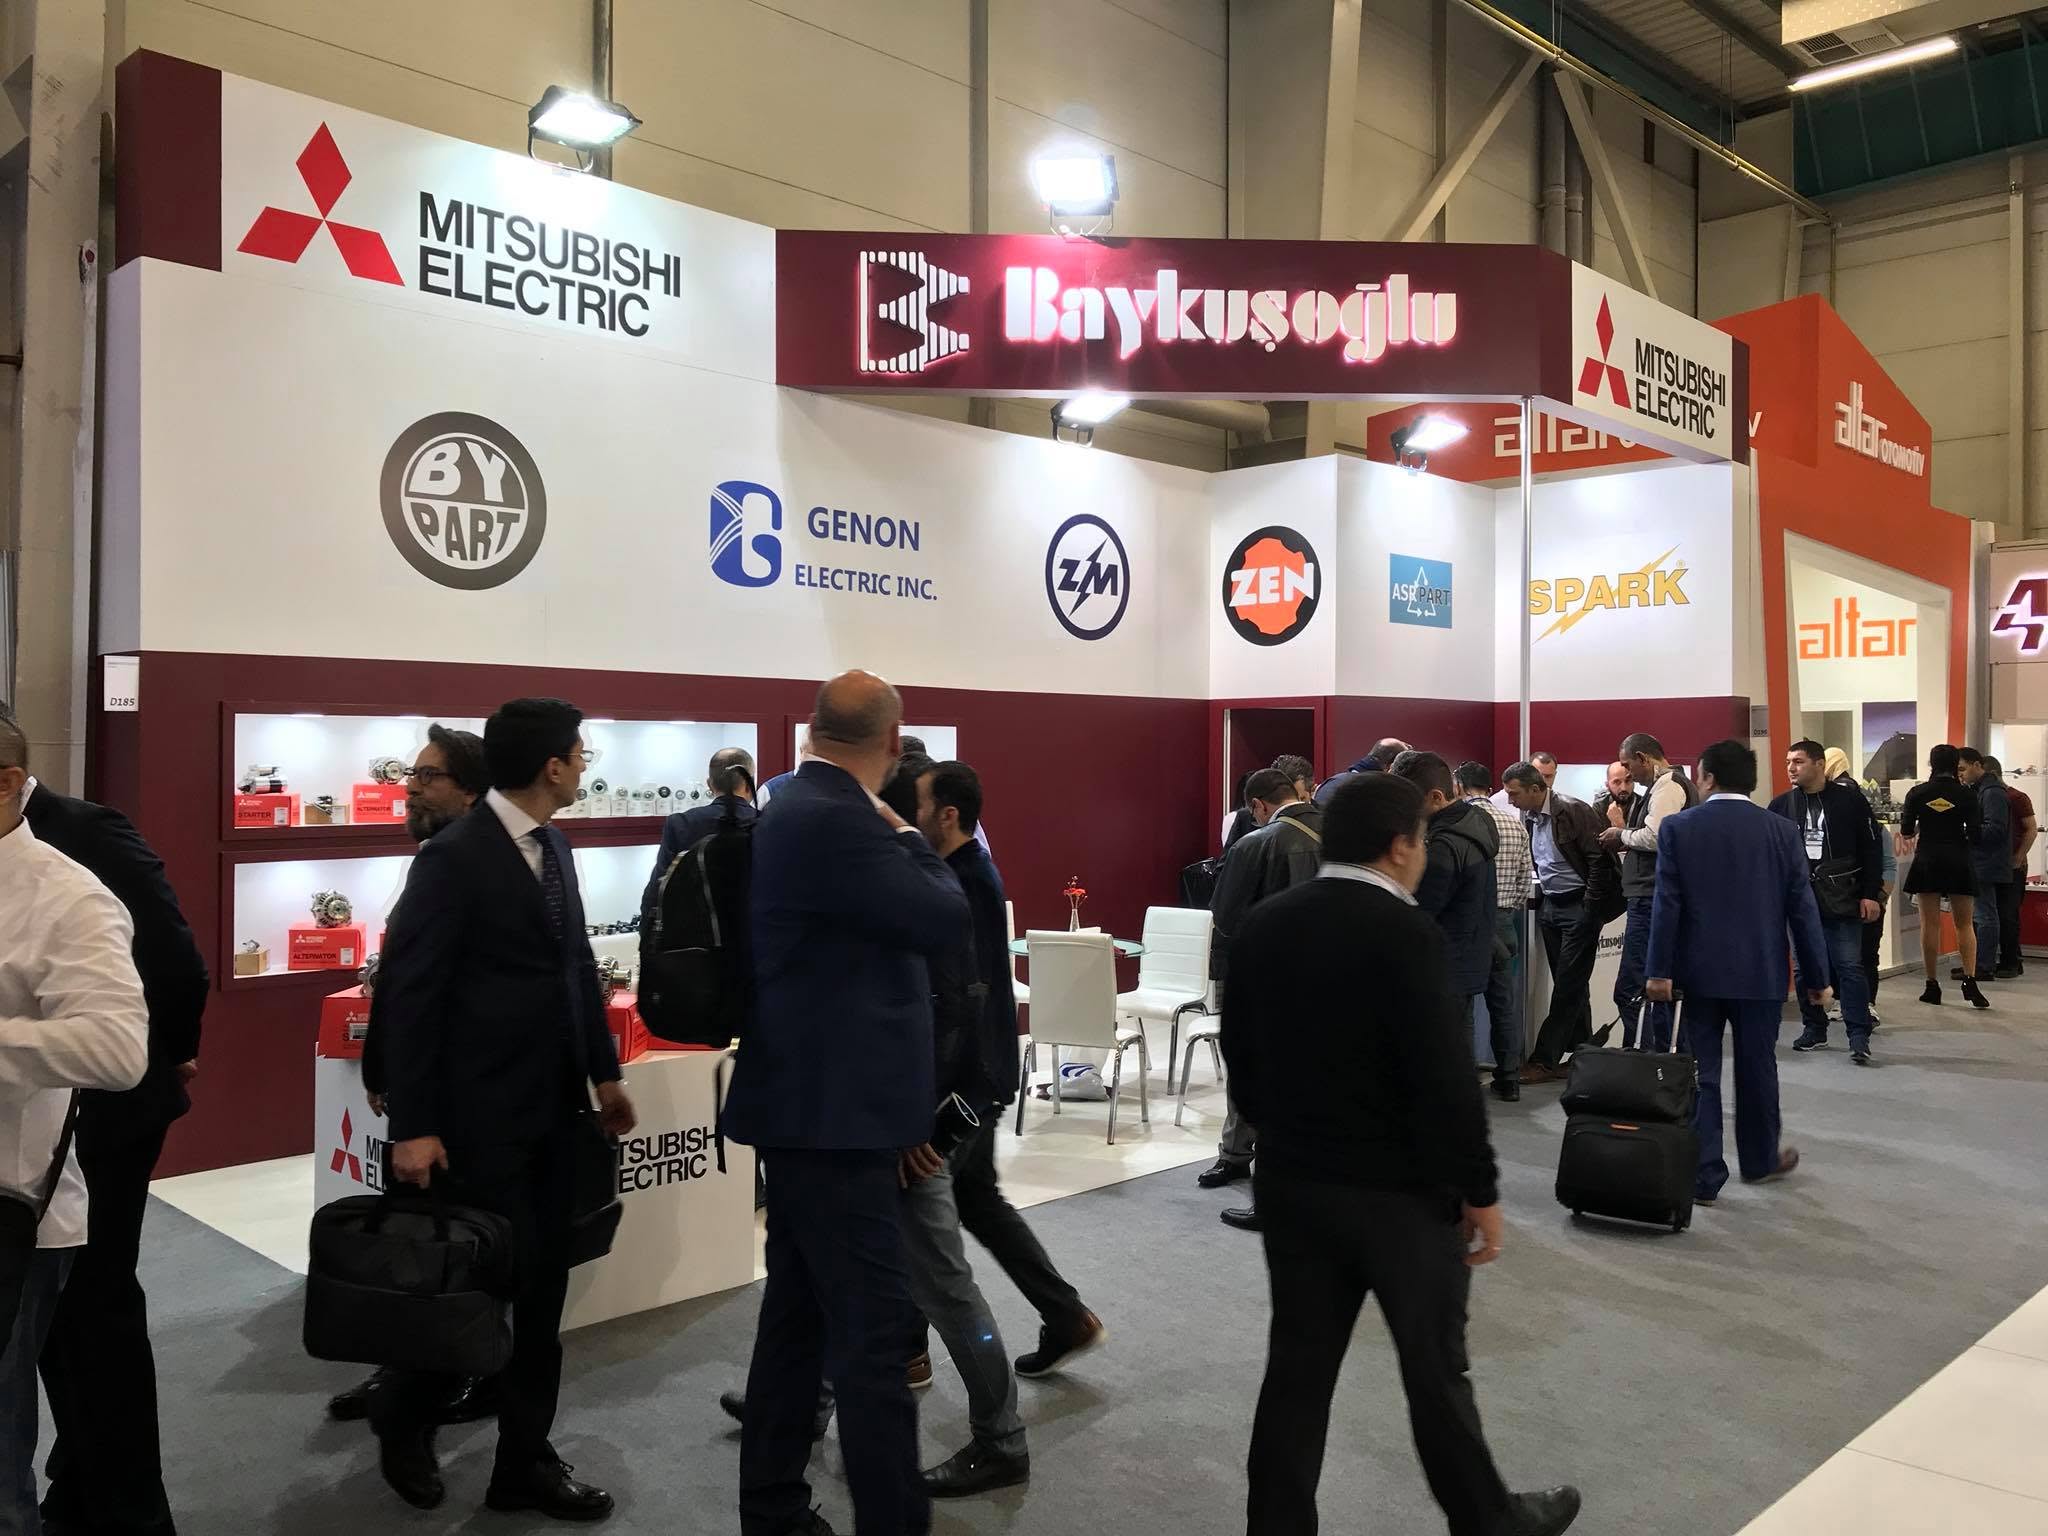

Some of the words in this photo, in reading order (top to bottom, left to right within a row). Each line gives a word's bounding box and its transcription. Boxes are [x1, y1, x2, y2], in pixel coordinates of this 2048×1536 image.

[419, 190, 682, 298] MITSUBISHI
[418, 249, 650, 338] ELECTRIC
[1635, 338, 1726, 408] MITSUBISHI
[1636, 378, 1715, 439] ELECTRIC
[1834, 381, 1888, 459] altar
[409, 441, 507, 500] BY
[416, 502, 521, 562] PART
[807, 506, 921, 552] GENON
[794, 563, 892, 597] ELECTRIC
[896, 576, 938, 602] INC.
[1056, 557, 1119, 598] ZM
[1229, 562, 1315, 608] ZEN
[1530, 568, 1690, 615] SPARK
[1799, 596, 1917, 660] altar
[110, 697, 136, 707] D185
[618, 1153, 708, 1195] ECTRIC
